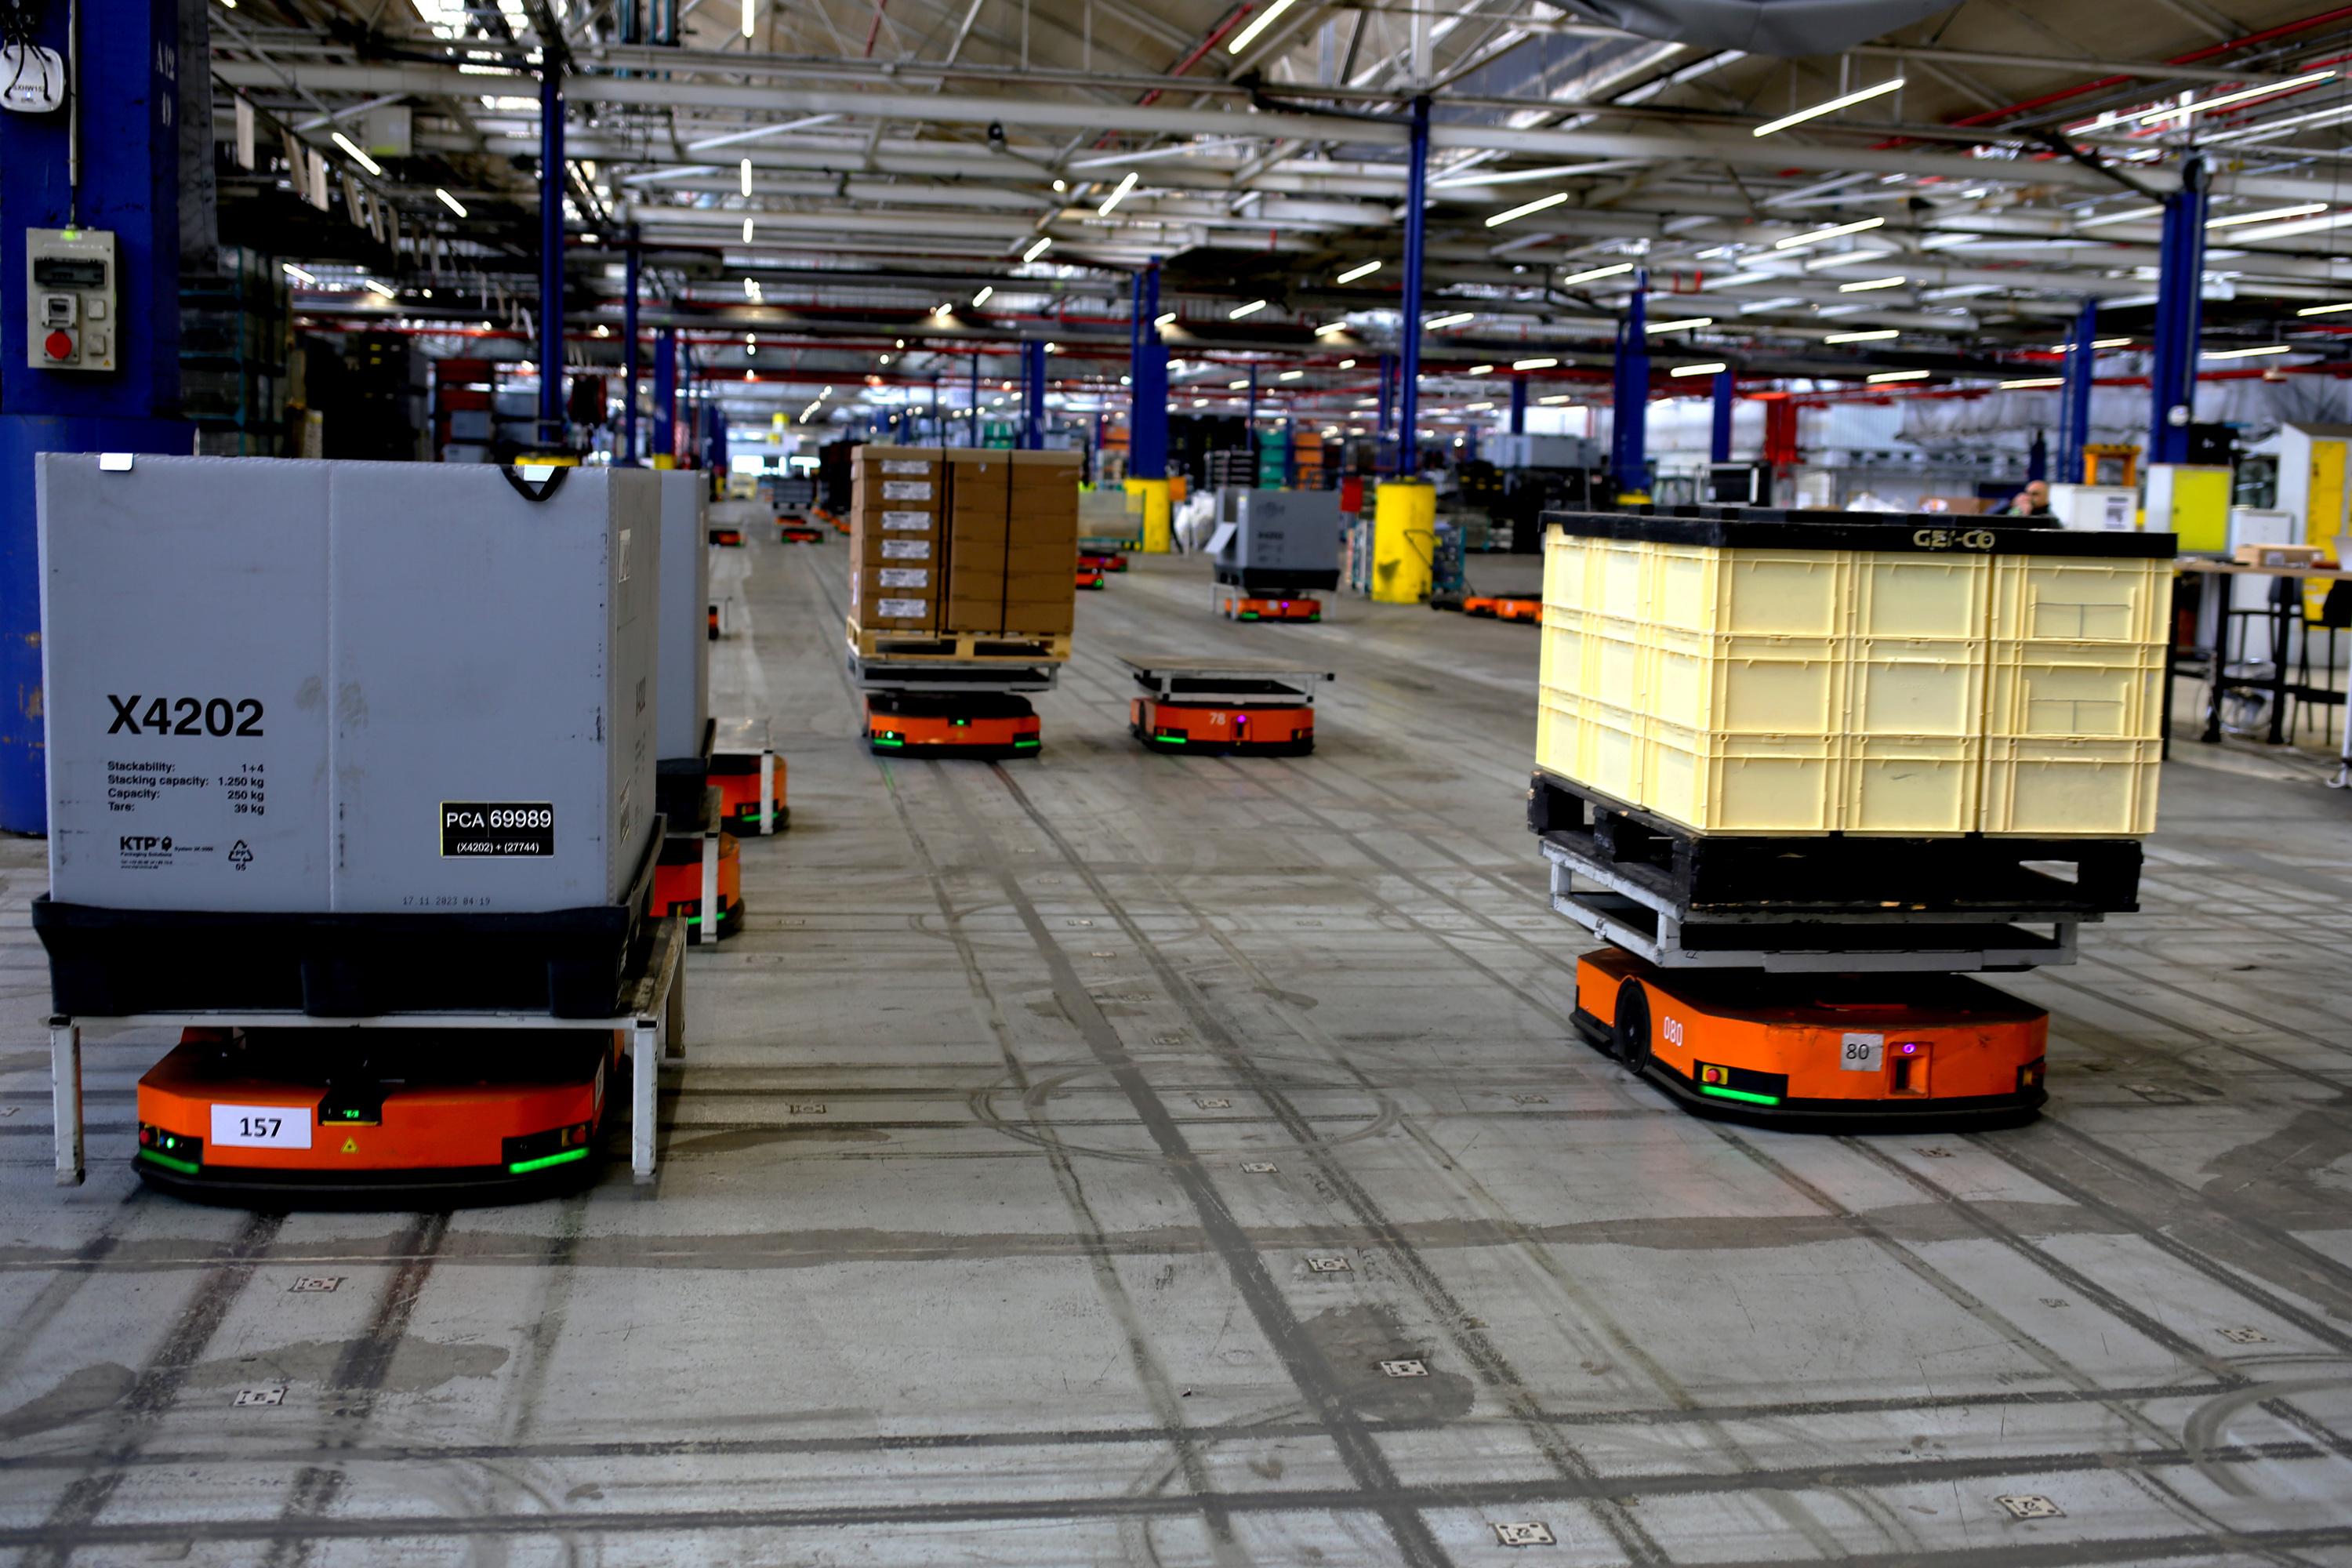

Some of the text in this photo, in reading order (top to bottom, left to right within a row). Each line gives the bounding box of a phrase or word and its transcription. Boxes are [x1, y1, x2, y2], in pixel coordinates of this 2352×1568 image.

[107, 695, 263, 737] X4202
[1209, 712, 1226, 726] 78
[107, 760, 176, 773] Stackability:
[107, 775, 209, 788] Stacking capacity:
[218, 777, 264, 789] 1.250 kg
[107, 788, 161, 800] Capacity:
[227, 789, 264, 802] 250 kg
[107, 801, 136, 812] Tare:
[234, 804, 264, 816] 39 kg
[446, 809, 552, 829] PCA 69989
[456, 842, 494, 854] (X4202)
[504, 842, 540, 854] (27744)
[1663, 1015, 1683, 1047] 080
[1846, 1043, 1870, 1060] 80
[239, 1116, 282, 1138] 157
